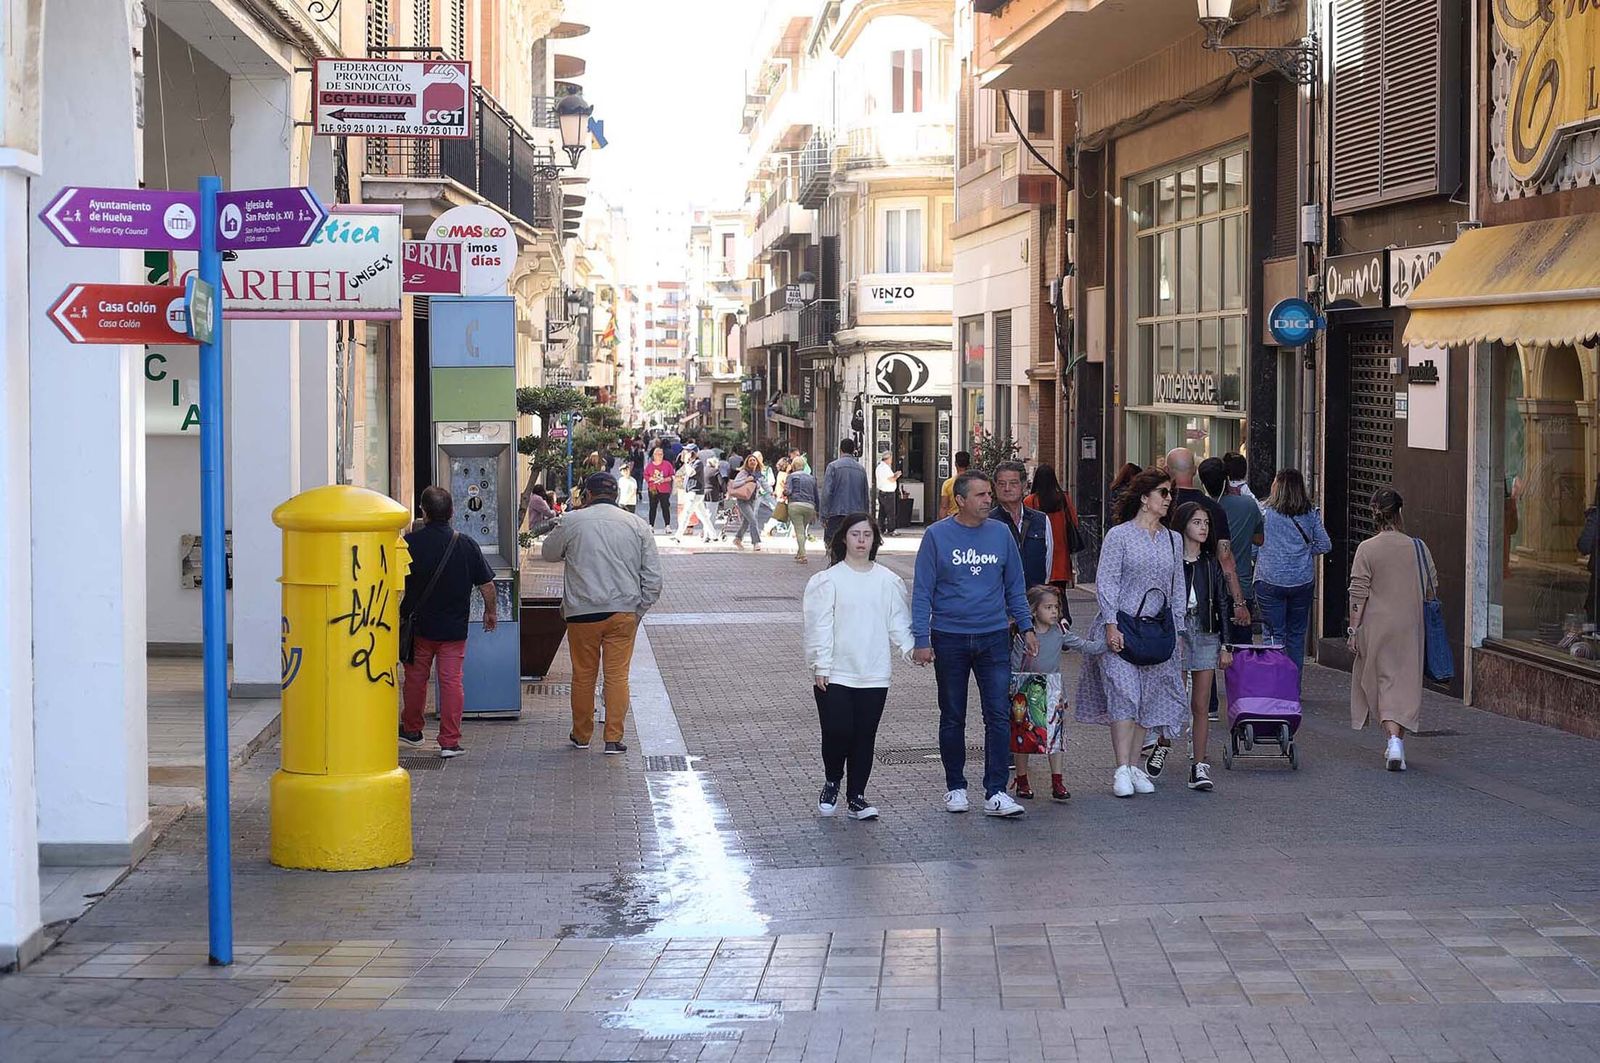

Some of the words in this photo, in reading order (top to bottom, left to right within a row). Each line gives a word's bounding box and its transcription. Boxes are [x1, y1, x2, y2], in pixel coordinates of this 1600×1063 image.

[333, 63, 404, 72] FEDERACION
[336, 72, 402, 81] PROVINCIAL
[326, 82, 342, 90] DE
[344, 82, 412, 91] SINDICATOS
[323, 93, 414, 105] CGT-HUELVA
[425, 109, 463, 125] CGT
[337, 124, 351, 133] 959
[353, 125, 363, 133] 25
[366, 125, 376, 133] 01
[378, 125, 387, 133] 21
[396, 125, 411, 134] FAX
[413, 126, 427, 135] 959
[431, 126, 440, 135] 25
[442, 127, 452, 135] 01
[454, 127, 464, 136] 17
[89, 199, 151, 213] Ayuntamiento
[245, 200, 264, 212] Iglesia
[265, 200, 273, 209] de
[89, 212, 100, 221] de
[102, 212, 132, 223] Huelva
[245, 213, 257, 222] San
[257, 212, 275, 221] Pedro
[283, 211, 294, 221] XV)
[89, 225, 111, 235] Huelva
[112, 226, 124, 236] City
[125, 227, 149, 236] Council
[266, 225, 281, 233] Church
[471, 254, 501, 266] días
[348, 253, 394, 289] UNISEX
[871, 286, 915, 299] VENZO
[98, 300, 124, 313] Casa
[126, 300, 157, 314] Colón
[98, 319, 117, 328] Casa
[118, 319, 141, 328] Colón
[1274, 319, 1314, 329] DIGI
[952, 548, 999, 566] Silbon
